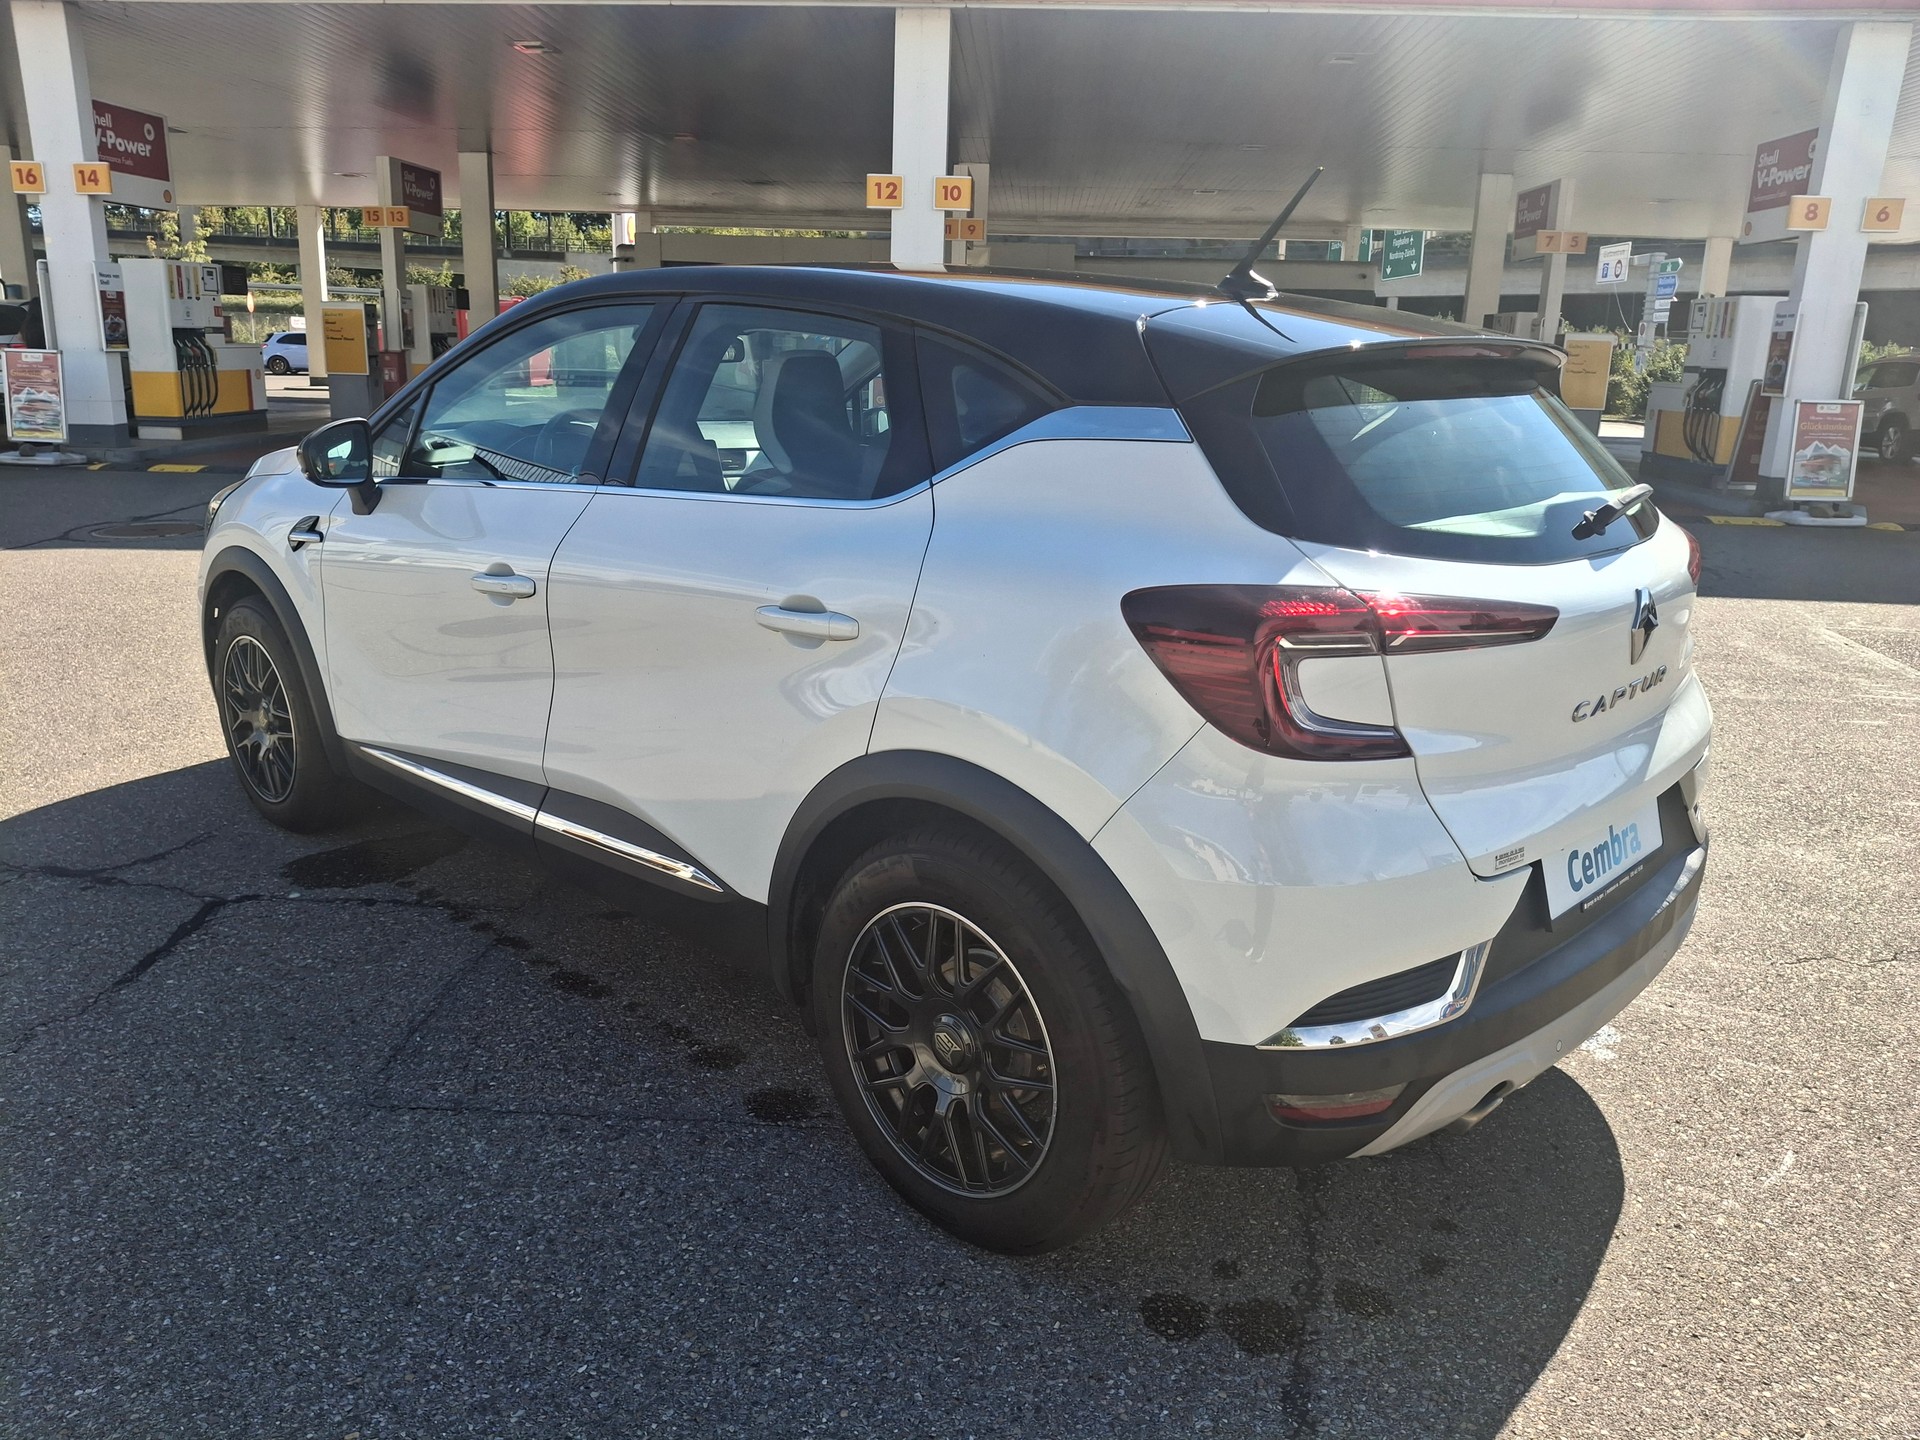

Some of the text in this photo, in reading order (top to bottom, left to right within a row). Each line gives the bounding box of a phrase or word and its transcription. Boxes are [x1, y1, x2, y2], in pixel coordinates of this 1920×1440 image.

[93, 110, 112, 128] hell
[1758, 150, 1779, 168] Shell
[15, 168, 38, 185] 16
[77, 169, 100, 187] 14
[1757, 163, 1811, 189] V-Power
[404, 181, 434, 200] V-Power
[874, 182, 898, 200] 12
[942, 185, 962, 201] 10
[366, 210, 380, 222] 15
[389, 210, 404, 222] 13
[1518, 210, 1543, 224] V-Power
[1804, 202, 1819, 221] 8
[1876, 205, 1890, 222] 6
[967, 224, 976, 235] 9
[1545, 235, 1554, 247] 7
[1570, 236, 1579, 247] 5
[1571, 665, 1667, 723] CAPTUR
[1567, 822, 1642, 893] Cembra
